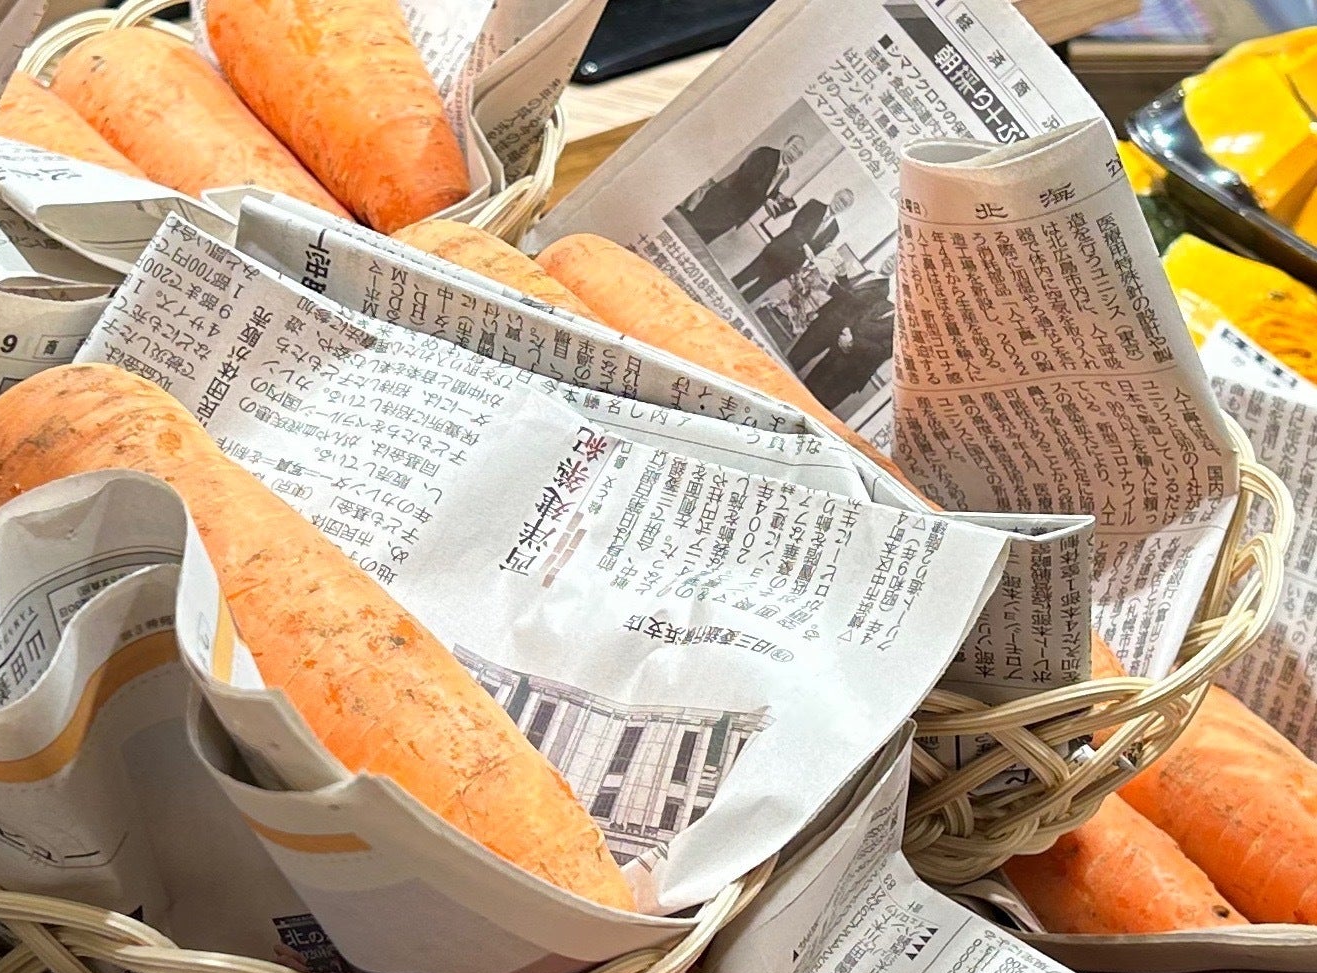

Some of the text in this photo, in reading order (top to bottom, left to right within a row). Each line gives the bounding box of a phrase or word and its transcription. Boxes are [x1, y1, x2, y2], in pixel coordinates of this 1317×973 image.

[194, 305, 273, 424] 民団体が販売
